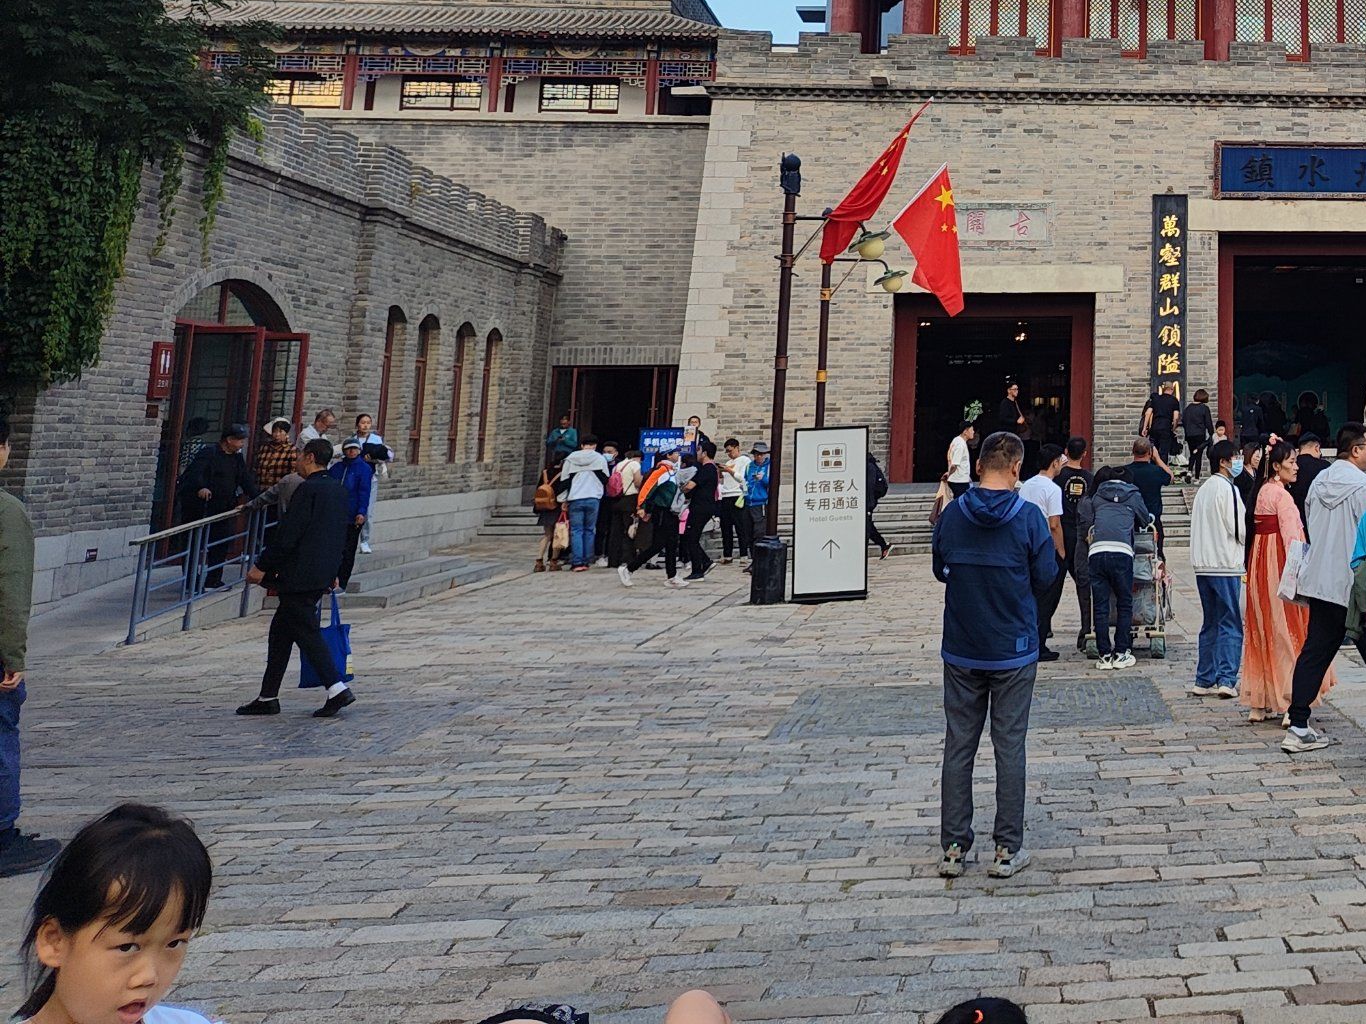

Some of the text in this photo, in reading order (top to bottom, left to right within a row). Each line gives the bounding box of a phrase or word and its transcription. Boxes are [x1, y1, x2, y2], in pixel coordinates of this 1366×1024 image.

[804, 478, 859, 495] 住宿客人
[803, 495, 859, 511] 专用通道
